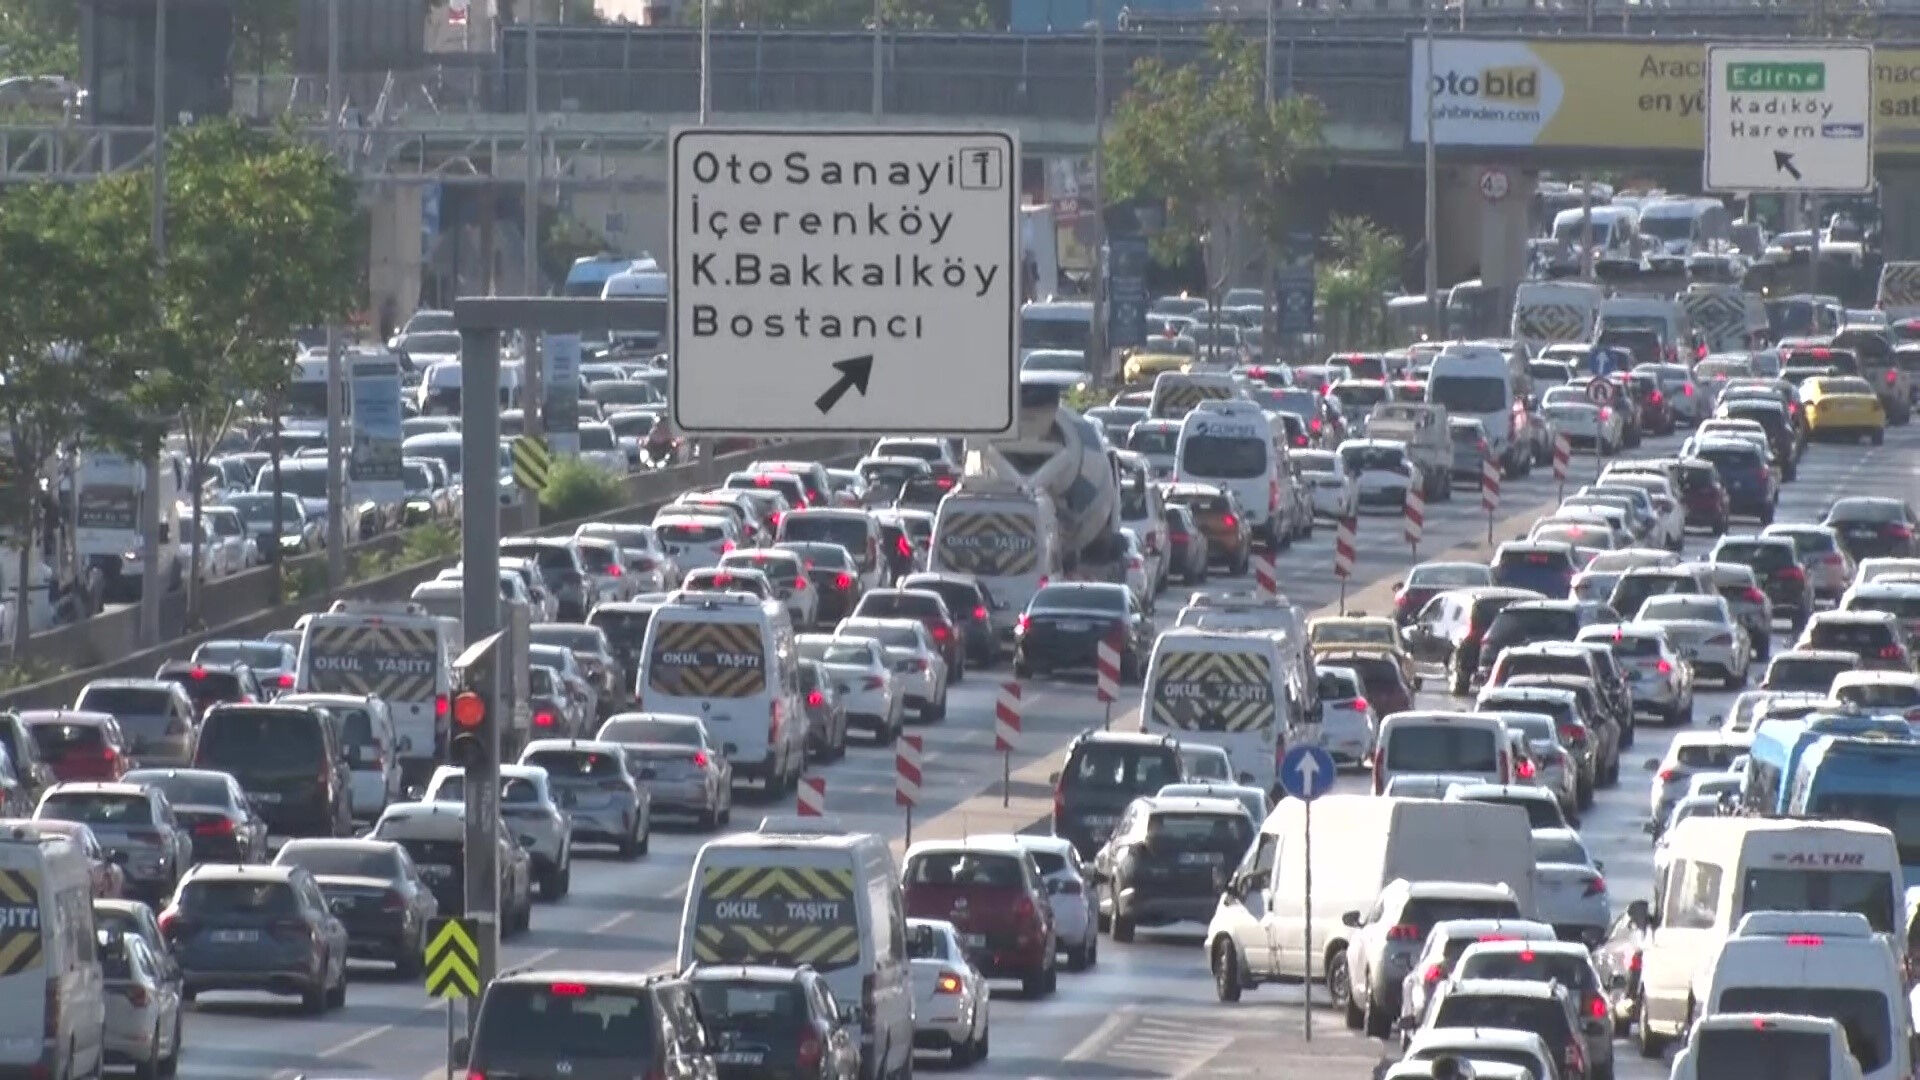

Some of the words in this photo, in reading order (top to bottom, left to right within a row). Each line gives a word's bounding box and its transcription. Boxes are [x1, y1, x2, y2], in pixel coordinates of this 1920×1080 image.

[1732, 67, 1818, 86] Edirne
[1638, 94, 1672, 113] en
[1730, 96, 1834, 119] Kadıköy
[1730, 121, 1815, 138] Harem
[692, 150, 773, 185] Oto
[784, 150, 954, 195] Sanayi
[692, 193, 953, 245] İçerenköy
[692, 252, 998, 297] K.Bakkalköy
[692, 304, 922, 338] Bostancı
[314, 656, 363, 671] OKUL
[662, 652, 701, 665] OKUL
[1164, 683, 1206, 698] OKUL
[715, 902, 762, 920] OKUL
[786, 902, 839, 922] TAŞITI
